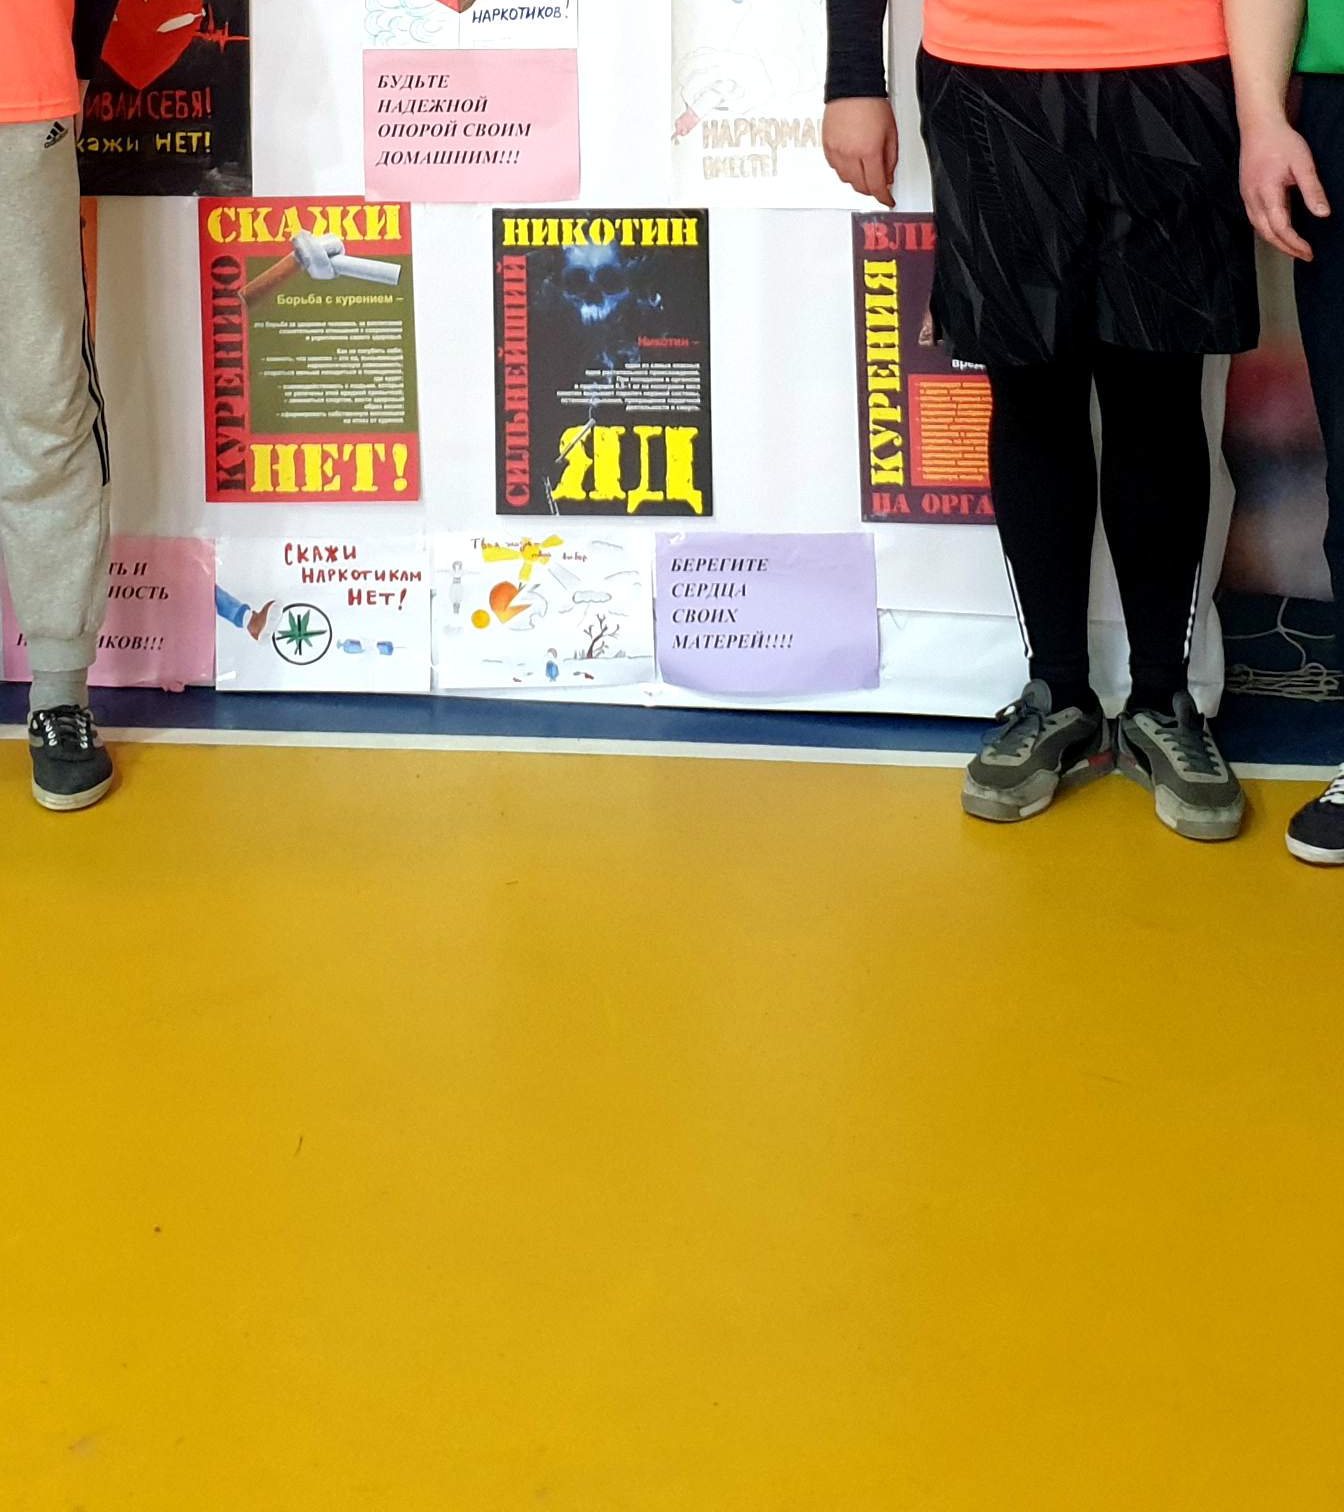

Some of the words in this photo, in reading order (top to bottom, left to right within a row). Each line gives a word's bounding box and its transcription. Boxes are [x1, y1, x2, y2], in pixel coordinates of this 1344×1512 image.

[377, 74, 450, 90] БУДЬТЕ
[146, 86, 213, 120] СЕБЯ!
[377, 95, 489, 115] НАДЕЖНОЙ
[377, 120, 458, 139] ОПОРОЙ
[462, 122, 532, 138] СВОИМ
[155, 131, 211, 154] НЕТ!
[375, 149, 521, 167] ДОМАШНИМ!!!
[207, 204, 402, 244] СКАЖИ
[502, 217, 699, 247] НИКОТИН
[276, 293, 323, 307] Борьба
[325, 296, 333, 304] с
[335, 295, 393, 307] курением
[210, 254, 247, 492] КУРЕНИЮ
[496, 254, 531, 507] СИЛЬНЕЙШИЙ
[863, 259, 905, 487] КУРЕНИЯ
[250, 442, 409, 494] НЕТ!
[551, 425, 703, 515] ЯД
[872, 492, 912, 514] НА
[283, 542, 358, 567] СКАЖИ
[670, 557, 770, 574] БЕРЕГИТЕ
[133, 562, 148, 577] И
[301, 566, 423, 584] НАРКОТИКАМ
[347, 587, 408, 611] НЕТ!
[670, 582, 748, 601] СЕРДЦА
[671, 608, 739, 624] СВОИХ
[671, 630, 794, 651] МАТЕРЕЙ!!!!
